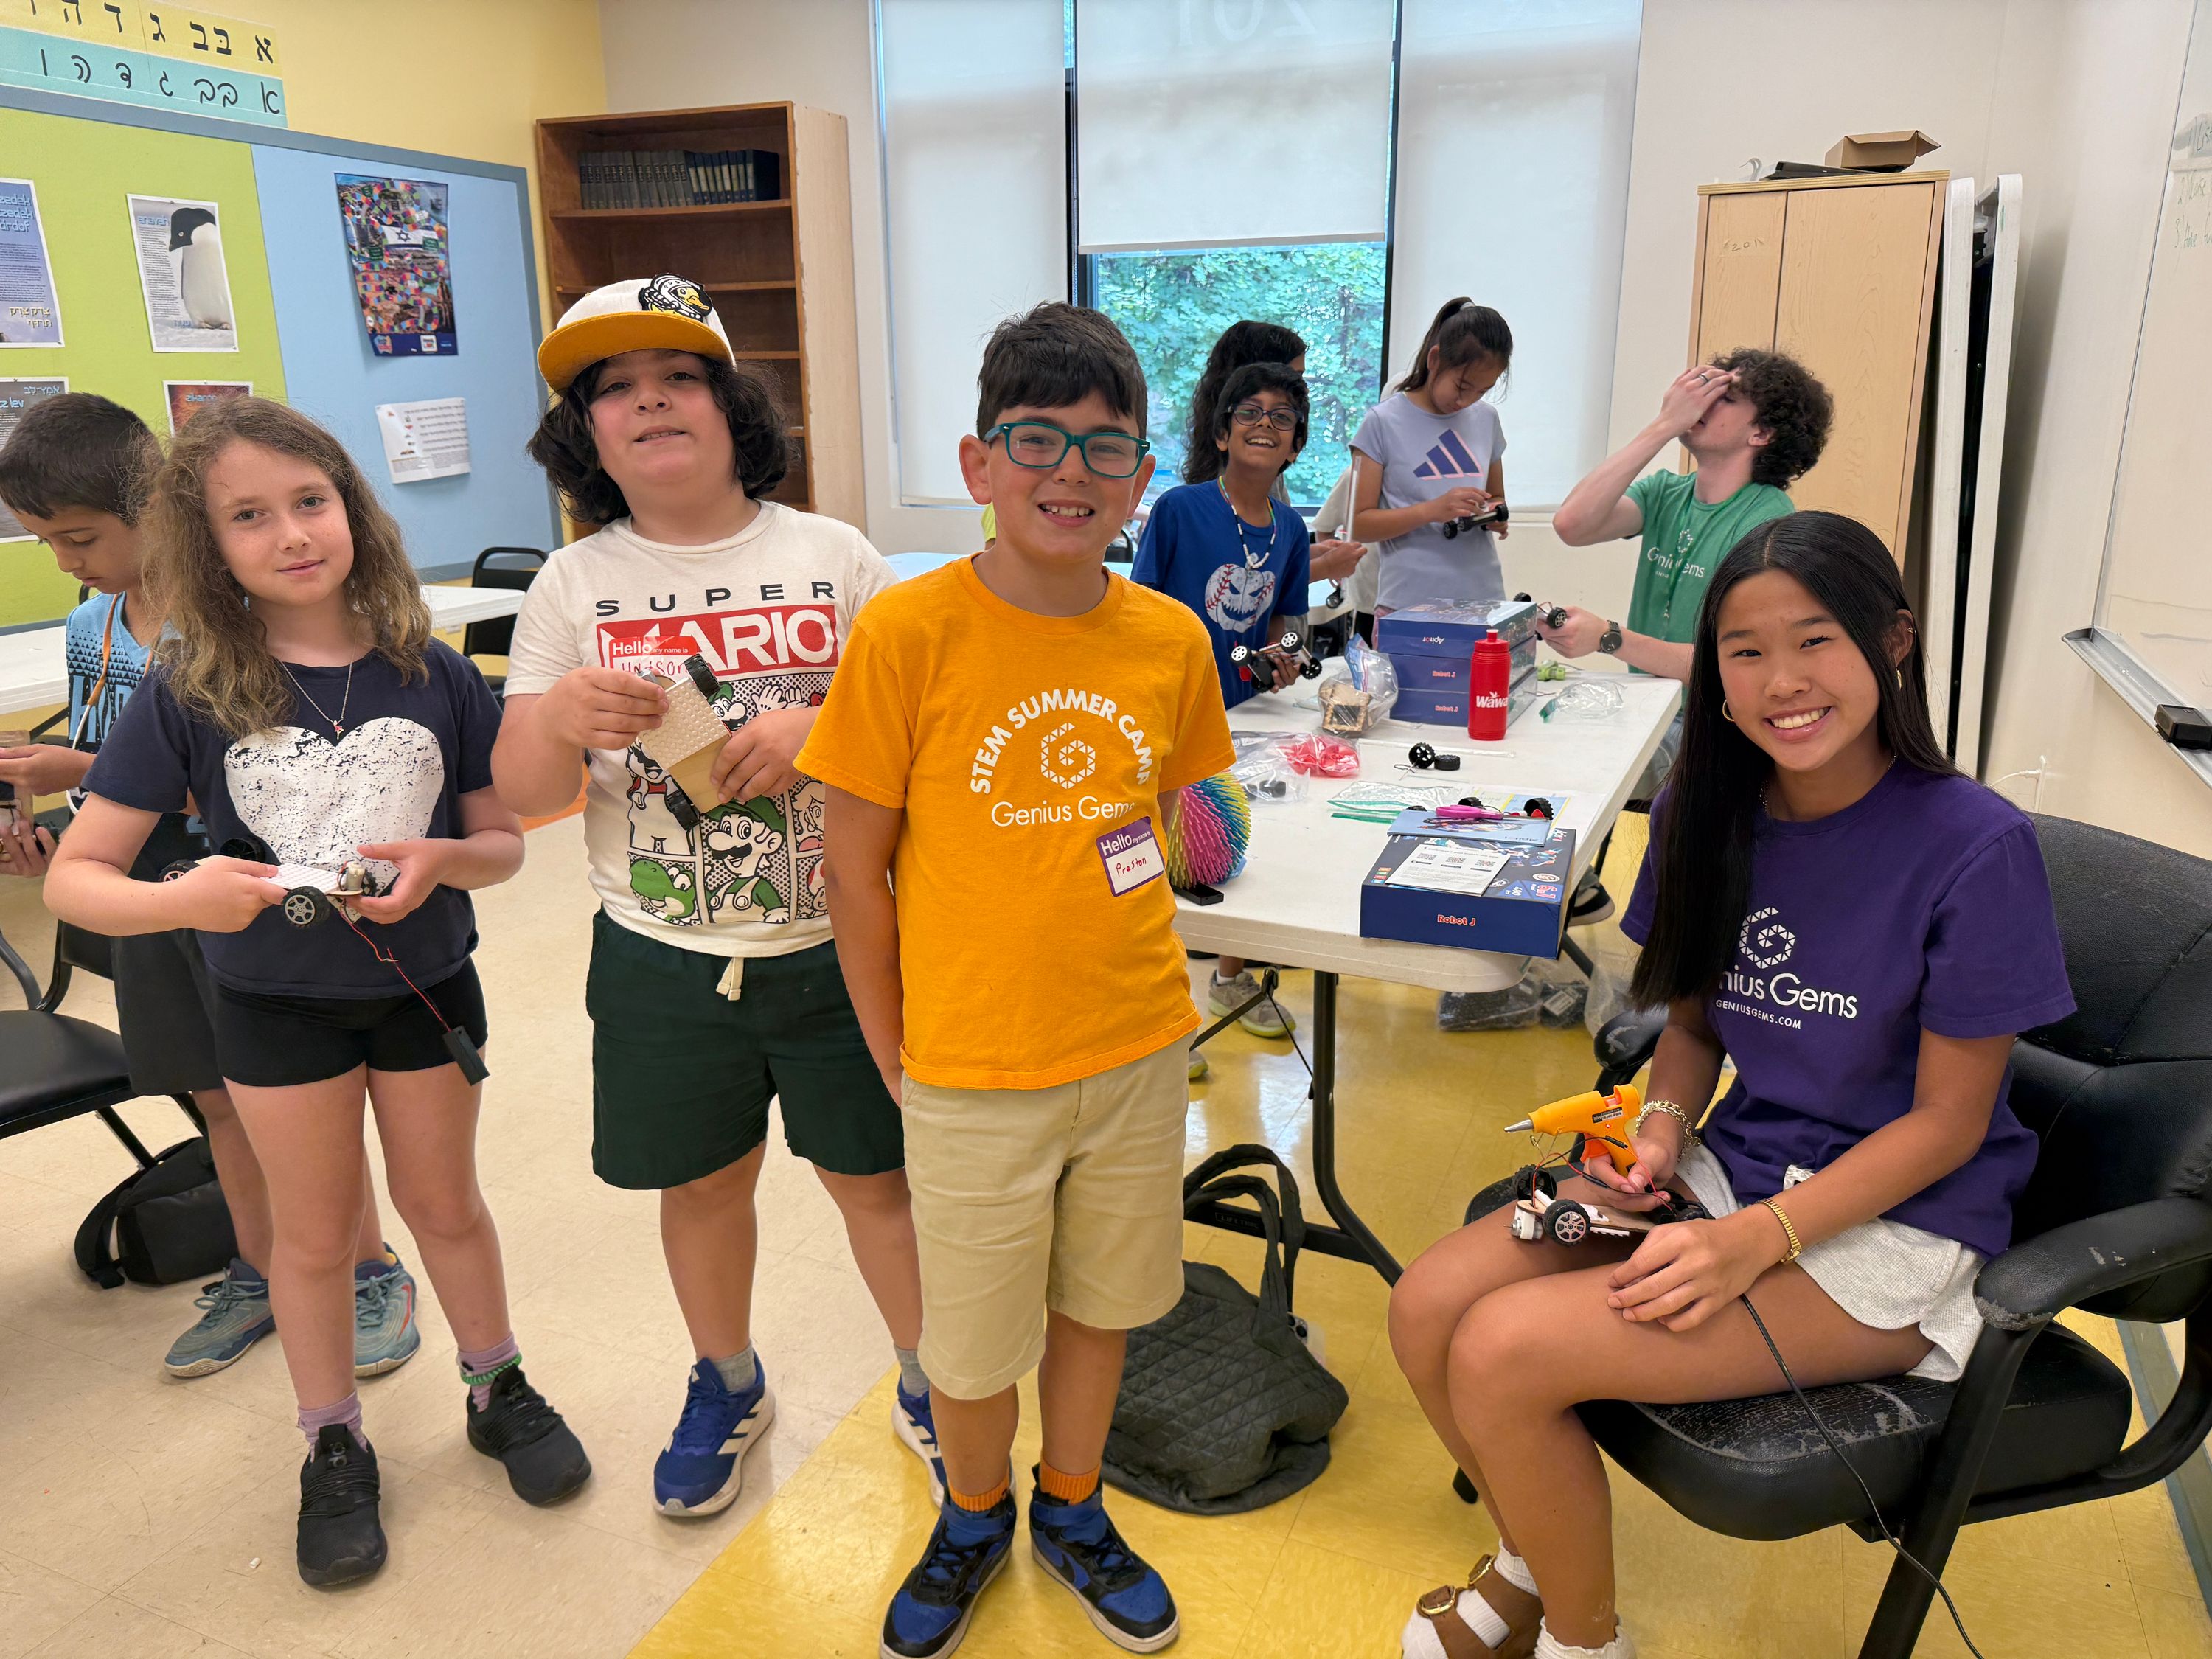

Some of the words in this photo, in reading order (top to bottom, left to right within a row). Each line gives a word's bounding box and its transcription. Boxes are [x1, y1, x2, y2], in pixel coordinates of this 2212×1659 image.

[150, 13, 166, 42] ג
[255, 35, 274, 63] א
[595, 581, 835, 617] SUPER
[613, 640, 653, 655] Hello
[1476, 695, 1509, 708] Wawa
[970, 725, 1012, 795] STEM
[1007, 688, 1117, 729] SUMMER
[991, 800, 1073, 827] Genius
[1100, 833, 1133, 856] Hello
[1438, 914, 1467, 925] Robot
[1469, 917, 1476, 927] J
[1719, 964, 1765, 1001] nius
[1770, 973, 1858, 1019] Gems
[1715, 999, 1801, 1029] GENIUSGEMS.COM
